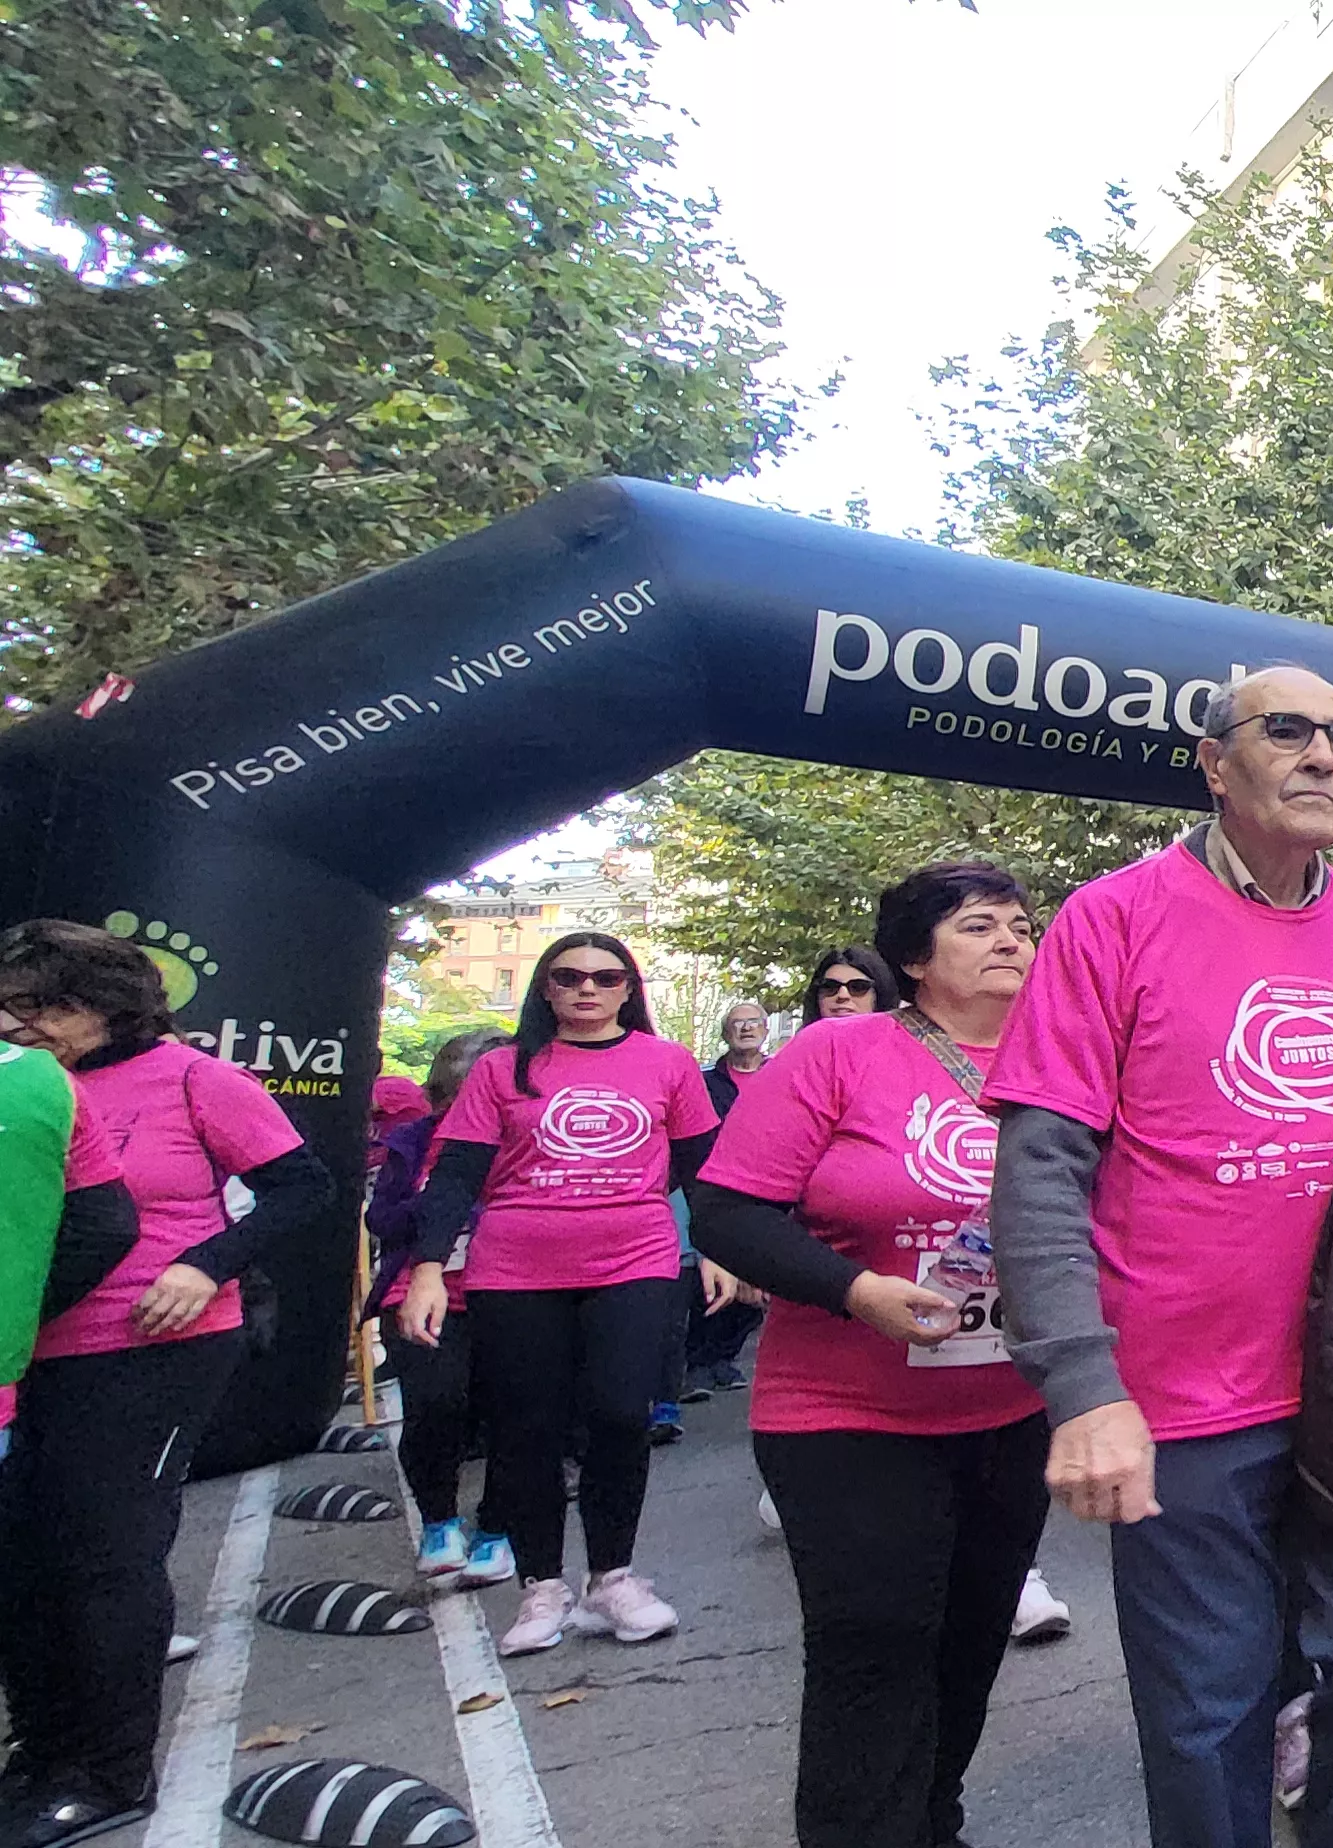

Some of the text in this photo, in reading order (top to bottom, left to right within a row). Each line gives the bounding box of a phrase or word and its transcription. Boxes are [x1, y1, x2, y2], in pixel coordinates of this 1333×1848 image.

[171, 578, 657, 809] Pisa bien, vive mejor
[907, 706, 1160, 764] PODOLOGÍA Y
